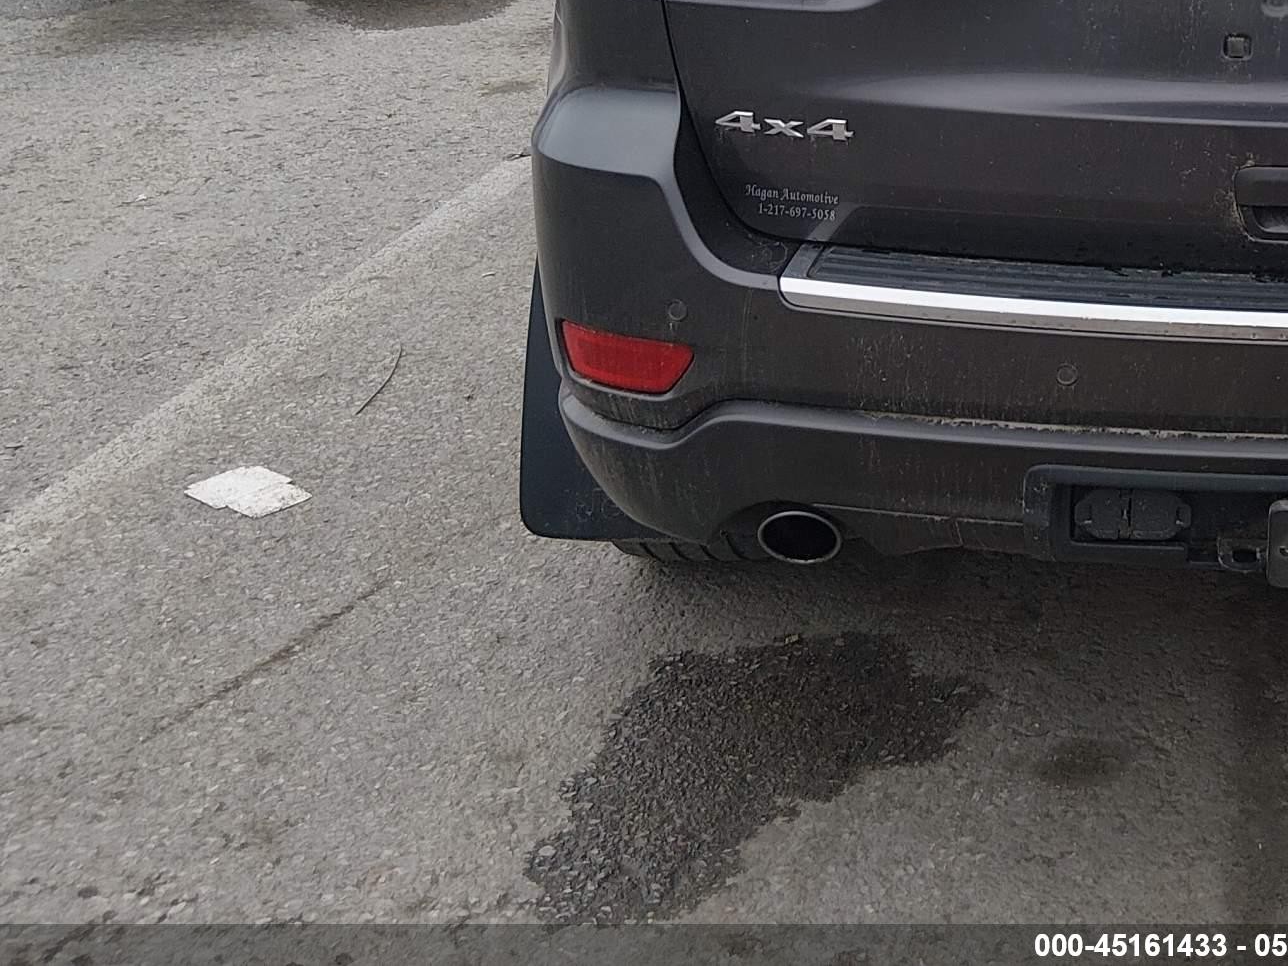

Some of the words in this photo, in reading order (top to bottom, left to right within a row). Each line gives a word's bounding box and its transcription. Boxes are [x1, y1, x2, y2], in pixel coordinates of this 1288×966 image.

[714, 109, 856, 142] 4x4
[745, 184, 779, 201] Hagan
[780, 187, 839, 205] Automotive
[758, 202, 837, 221] 1-217-697-5058
